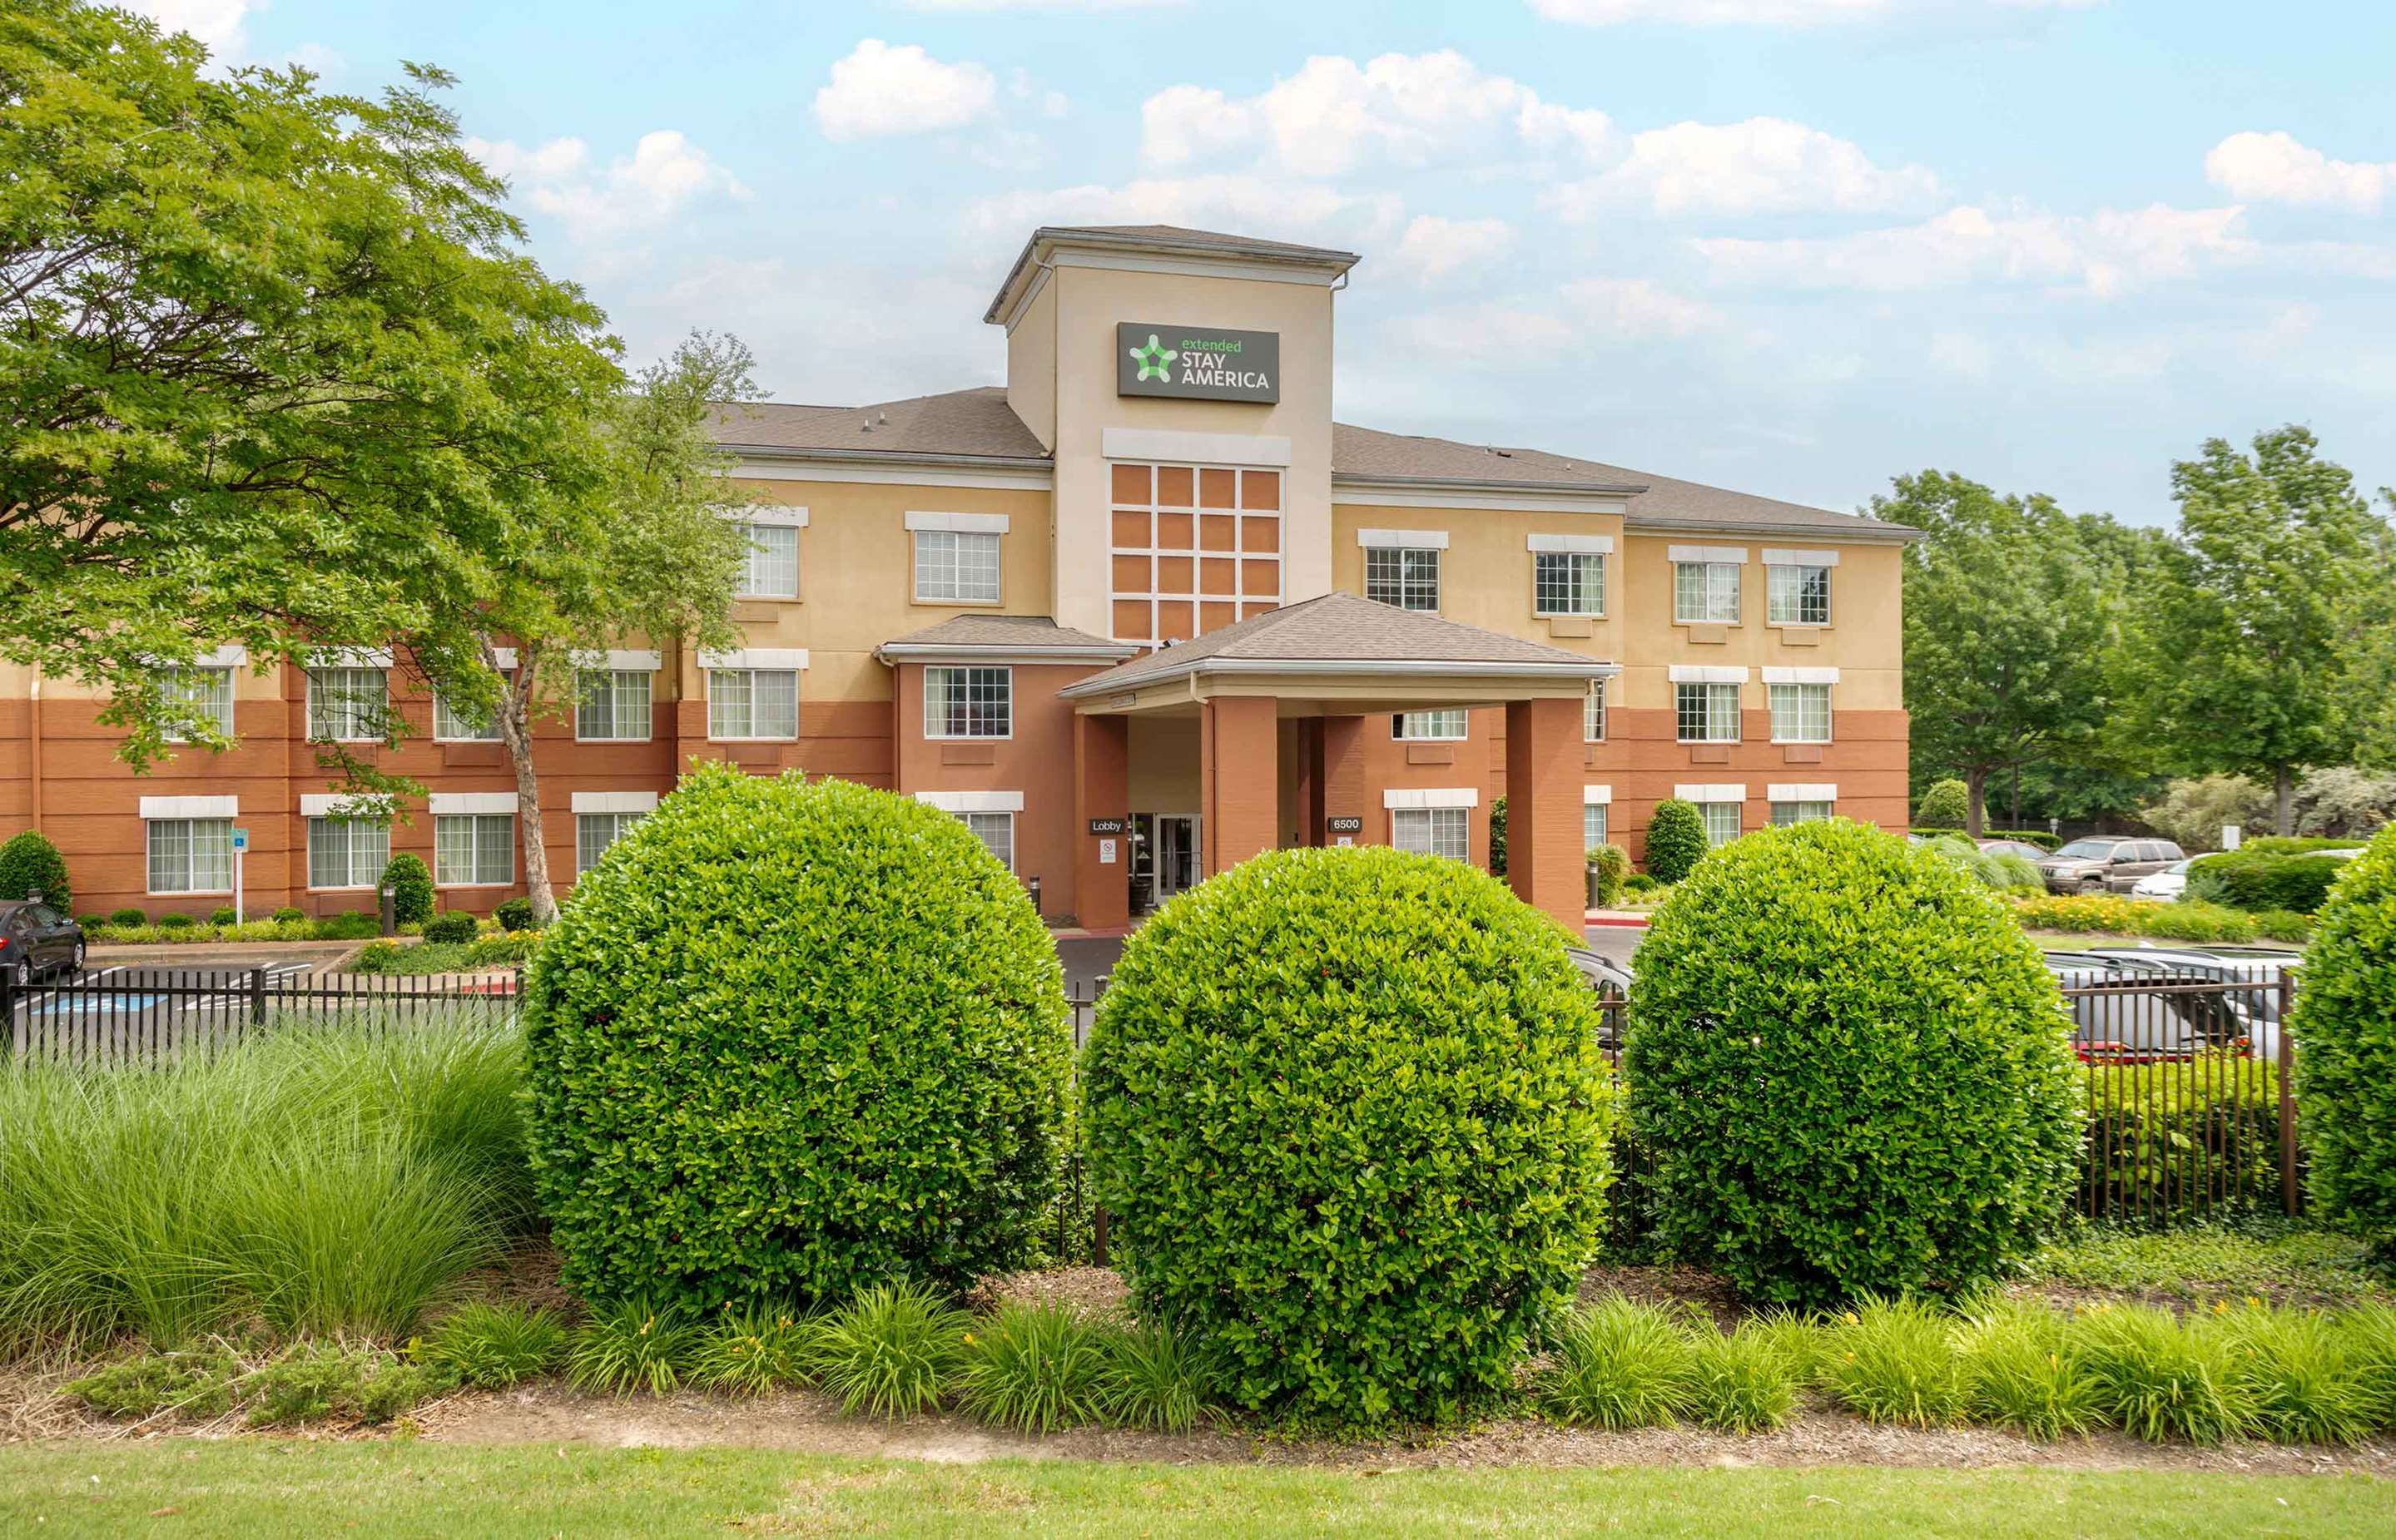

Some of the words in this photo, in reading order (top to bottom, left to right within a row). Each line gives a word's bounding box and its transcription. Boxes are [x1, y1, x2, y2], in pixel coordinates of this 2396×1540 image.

[1182, 339, 1242, 353] extended
[1182, 351, 1226, 369] STAY
[1182, 369, 1269, 389] AMERICA
[1093, 820, 1121, 832] Lobby
[1333, 819, 1359, 829] 6500
